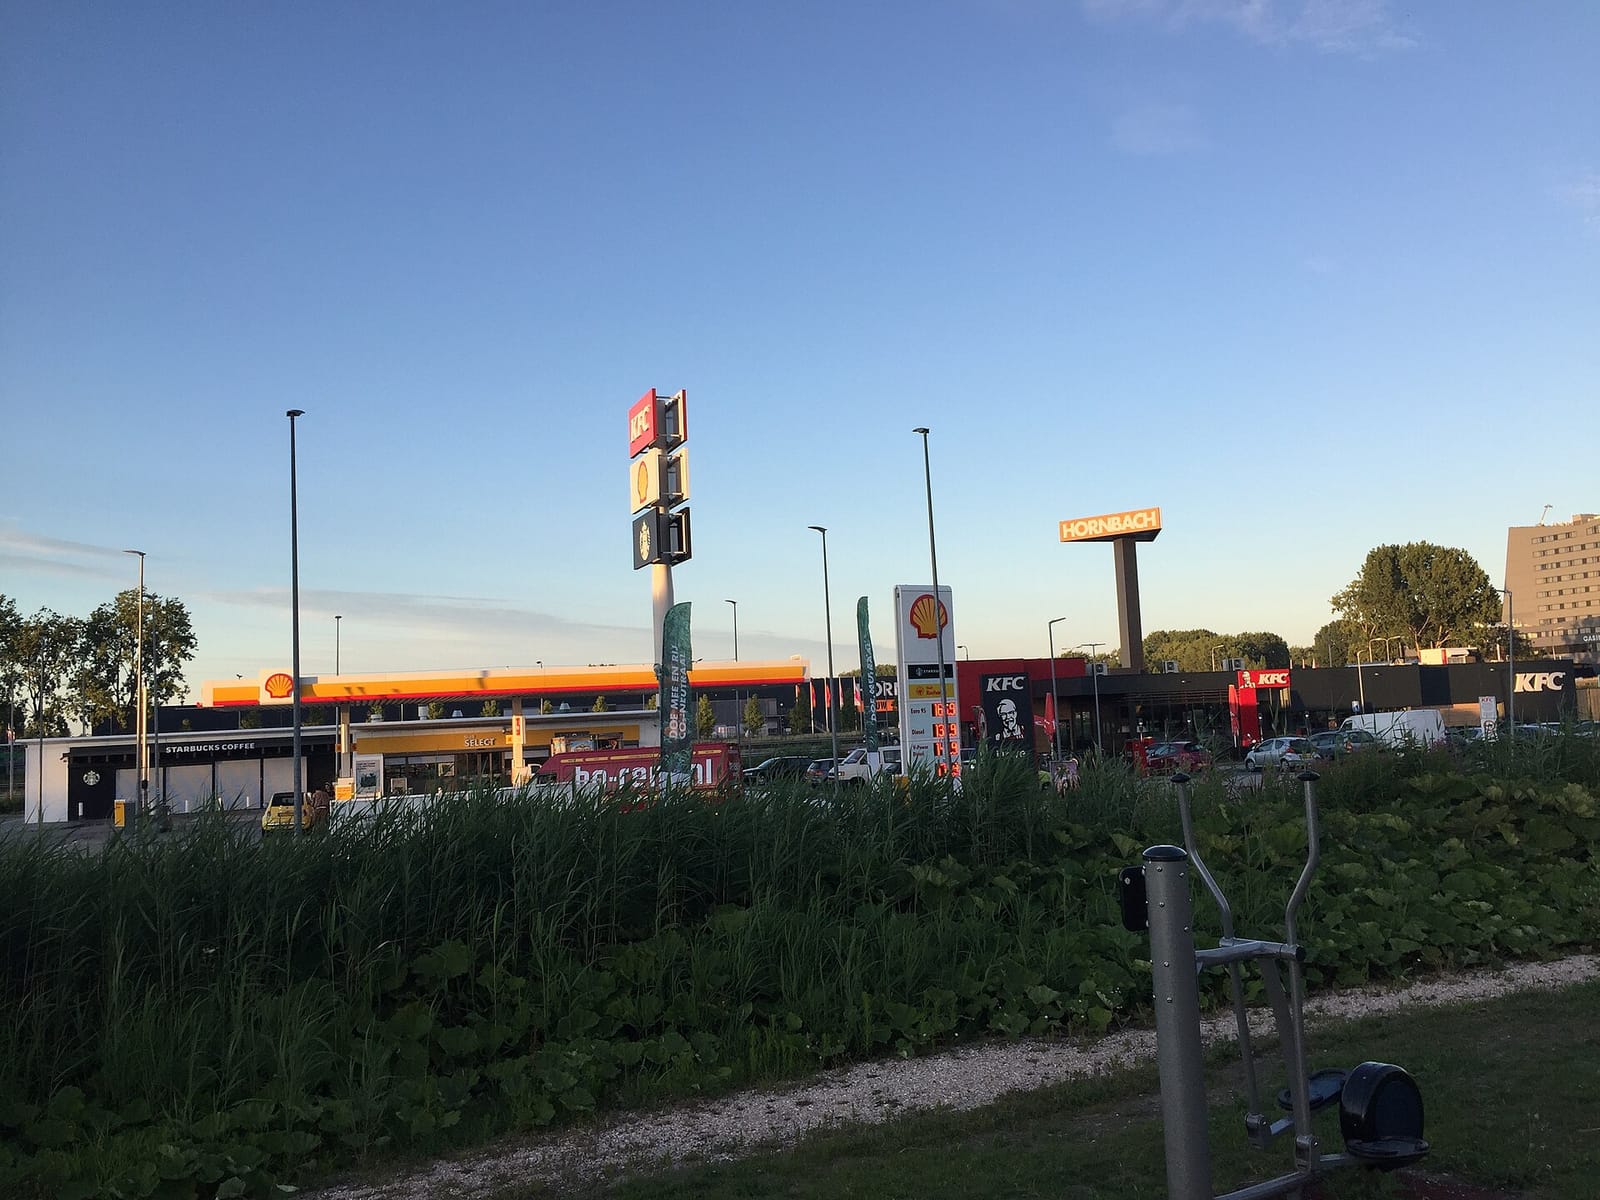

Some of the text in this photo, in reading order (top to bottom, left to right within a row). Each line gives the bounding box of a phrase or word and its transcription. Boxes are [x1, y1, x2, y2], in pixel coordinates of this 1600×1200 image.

[631, 405, 651, 442] KFC
[1062, 510, 1156, 538] HORNBACH
[671, 665, 679, 682] EN
[1258, 672, 1288, 685] KFC
[1514, 672, 1566, 692] KFC
[986, 676, 1026, 692] KFC
[670, 685, 679, 709] MEE
[669, 713, 679, 739] DOE
[935, 723, 957, 737] 139
[166, 743, 255, 753] STARBUCKS COFFEE
[464, 738, 496, 747] SELECT
